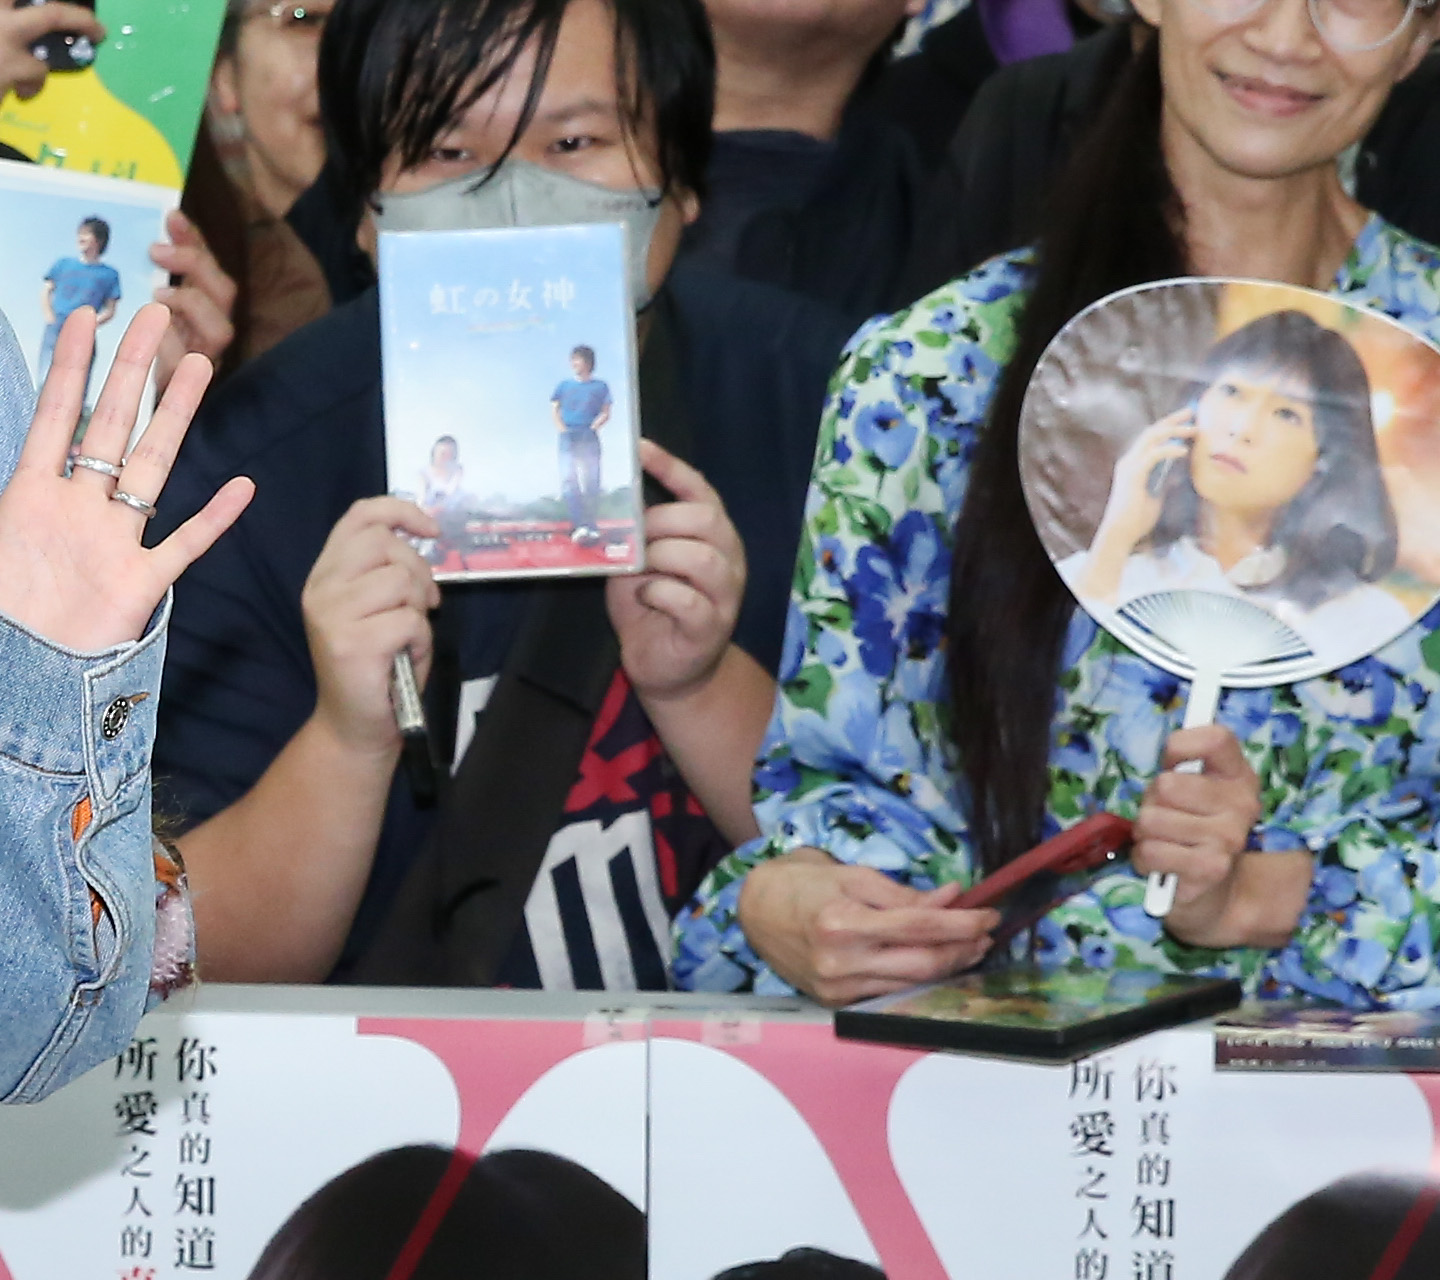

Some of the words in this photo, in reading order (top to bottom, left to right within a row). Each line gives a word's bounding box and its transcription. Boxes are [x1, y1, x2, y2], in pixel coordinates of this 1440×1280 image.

[174, 1036, 218, 1272] 你真的知道
